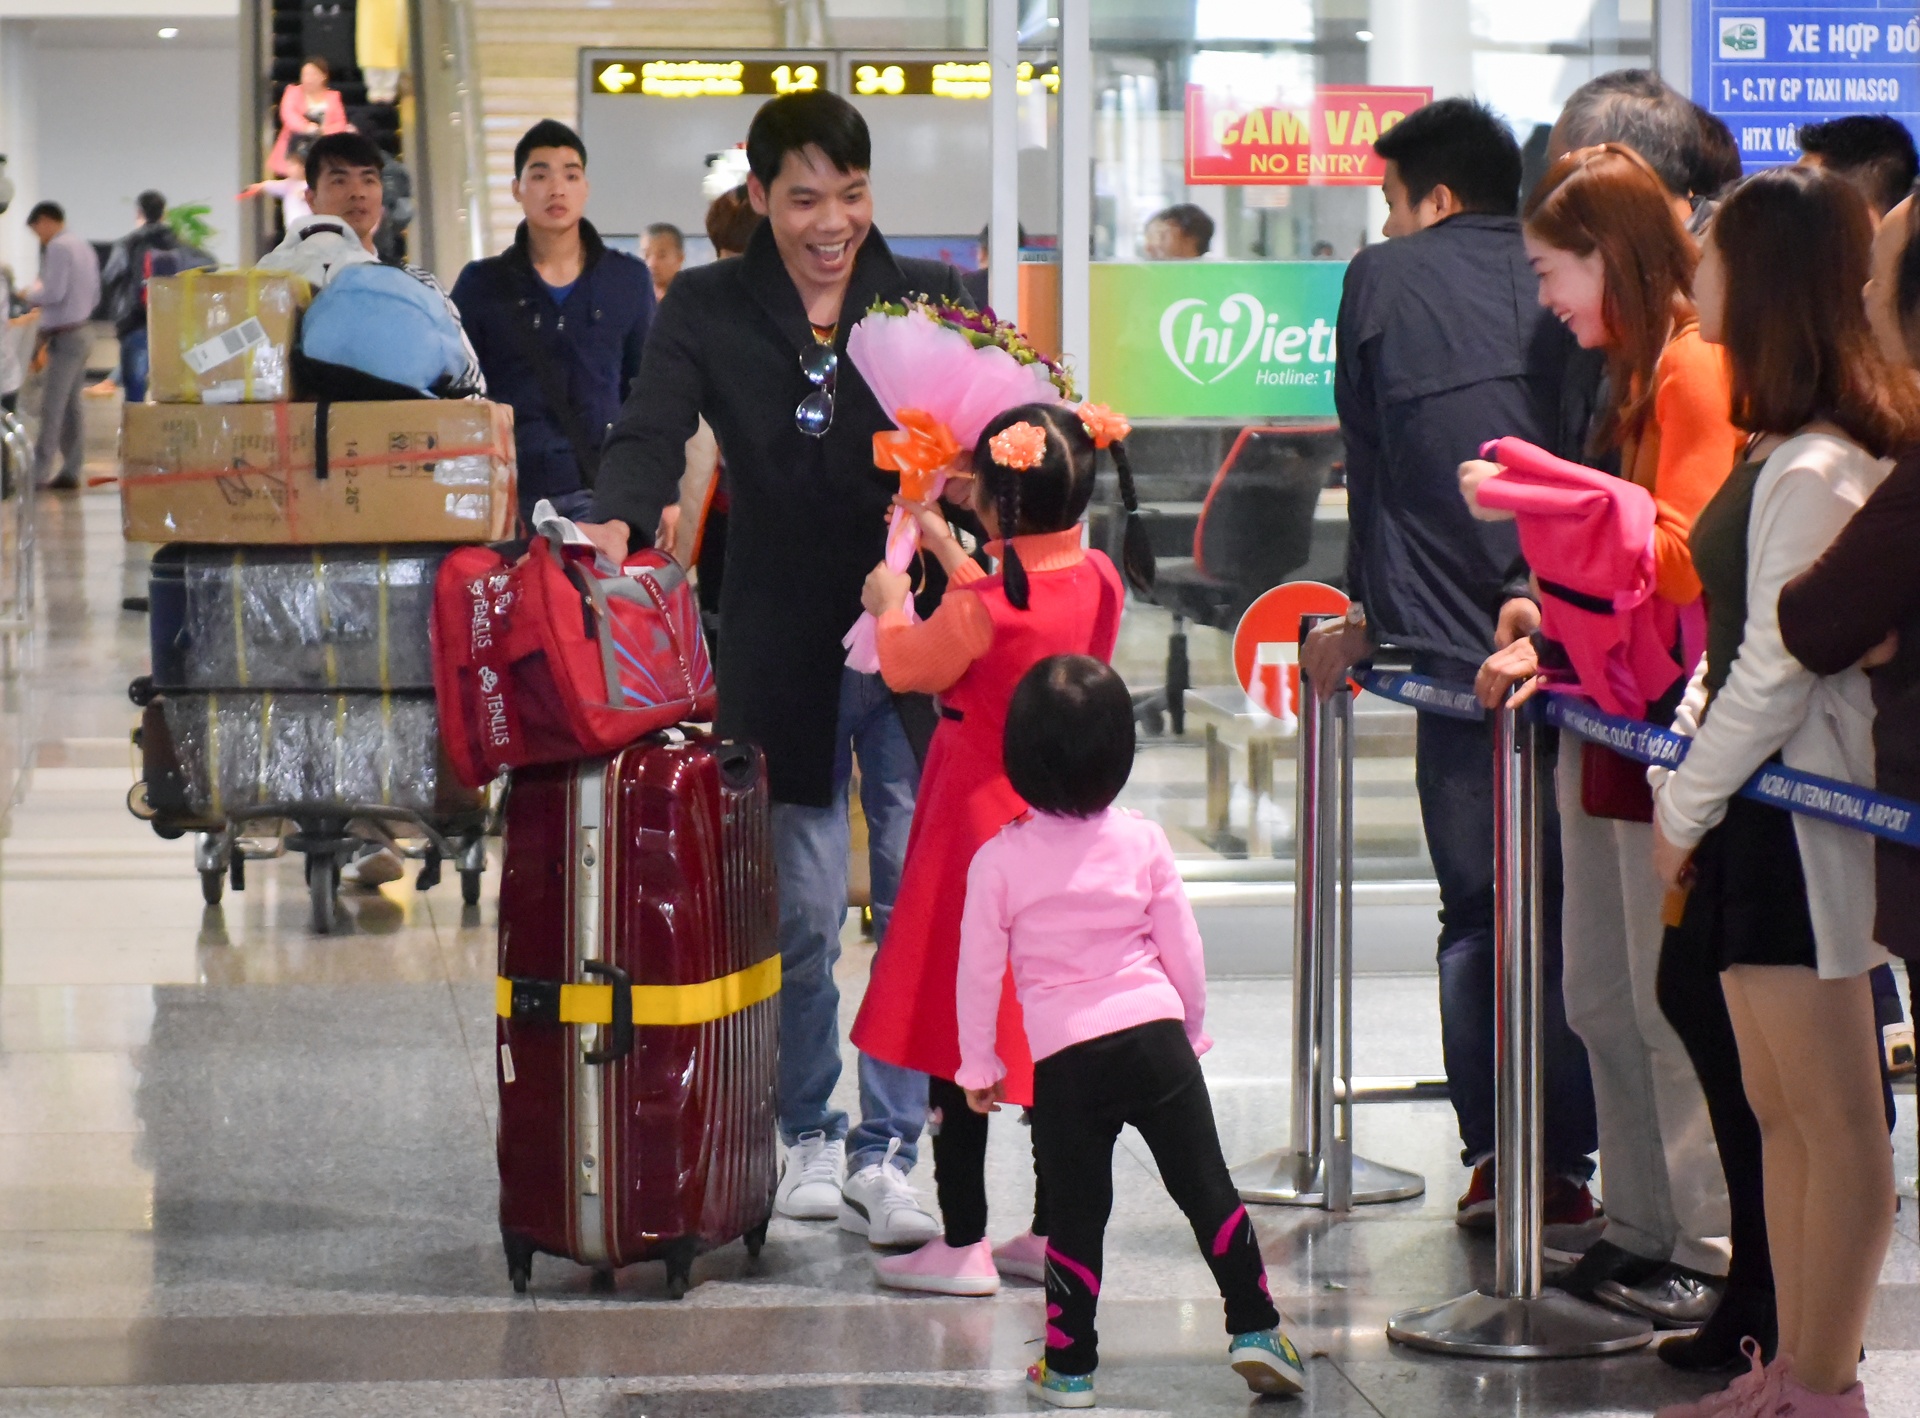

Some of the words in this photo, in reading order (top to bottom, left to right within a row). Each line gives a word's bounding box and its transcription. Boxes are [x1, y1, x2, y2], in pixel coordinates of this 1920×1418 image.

[1788, 23, 1820, 52] XE
[1828, 22, 1879, 59] HỢP
[1722, 78, 1738, 101] 1-
[1743, 78, 1775, 102] C.TY
[1780, 78, 1801, 101] CP
[1806, 78, 1841, 101] TAXI
[1845, 78, 1899, 101] NASCO
[1742, 127, 1772, 151] HTX
[1250, 154, 1289, 173] NO
[1297, 154, 1368, 173] ENTRY
[1255, 368, 1319, 385] Hotline:
